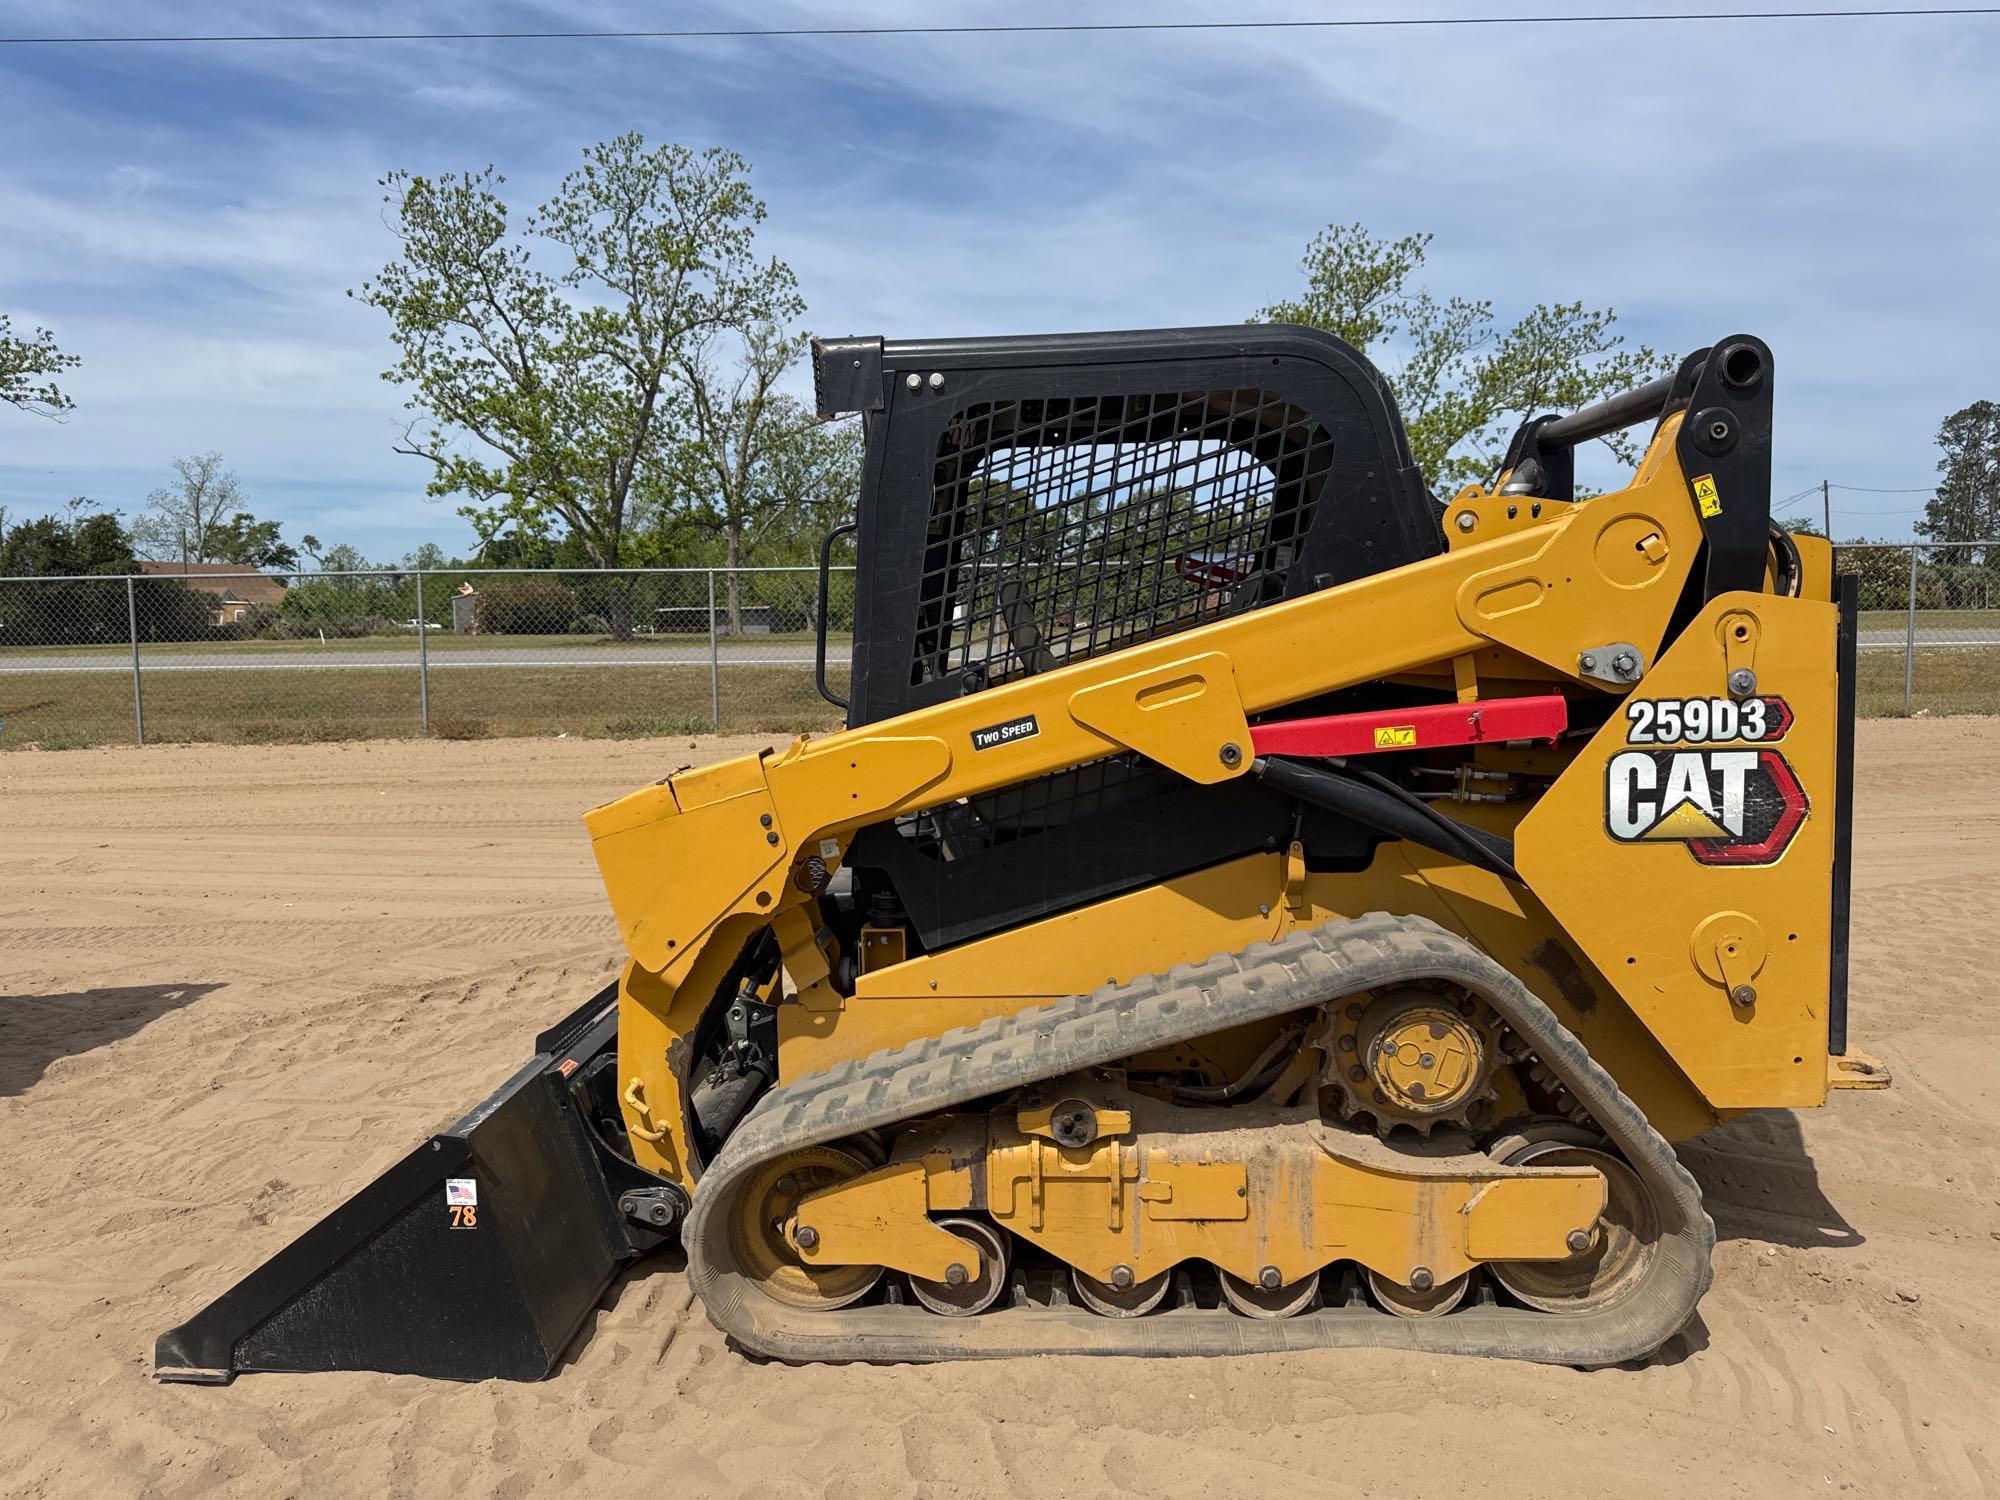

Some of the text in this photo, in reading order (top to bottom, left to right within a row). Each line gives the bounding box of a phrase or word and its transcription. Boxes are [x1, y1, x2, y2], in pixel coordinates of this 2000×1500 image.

[1628, 699, 1766, 742] 259D3
[1609, 752, 1758, 838] CAT
[449, 1206, 477, 1227] 78
